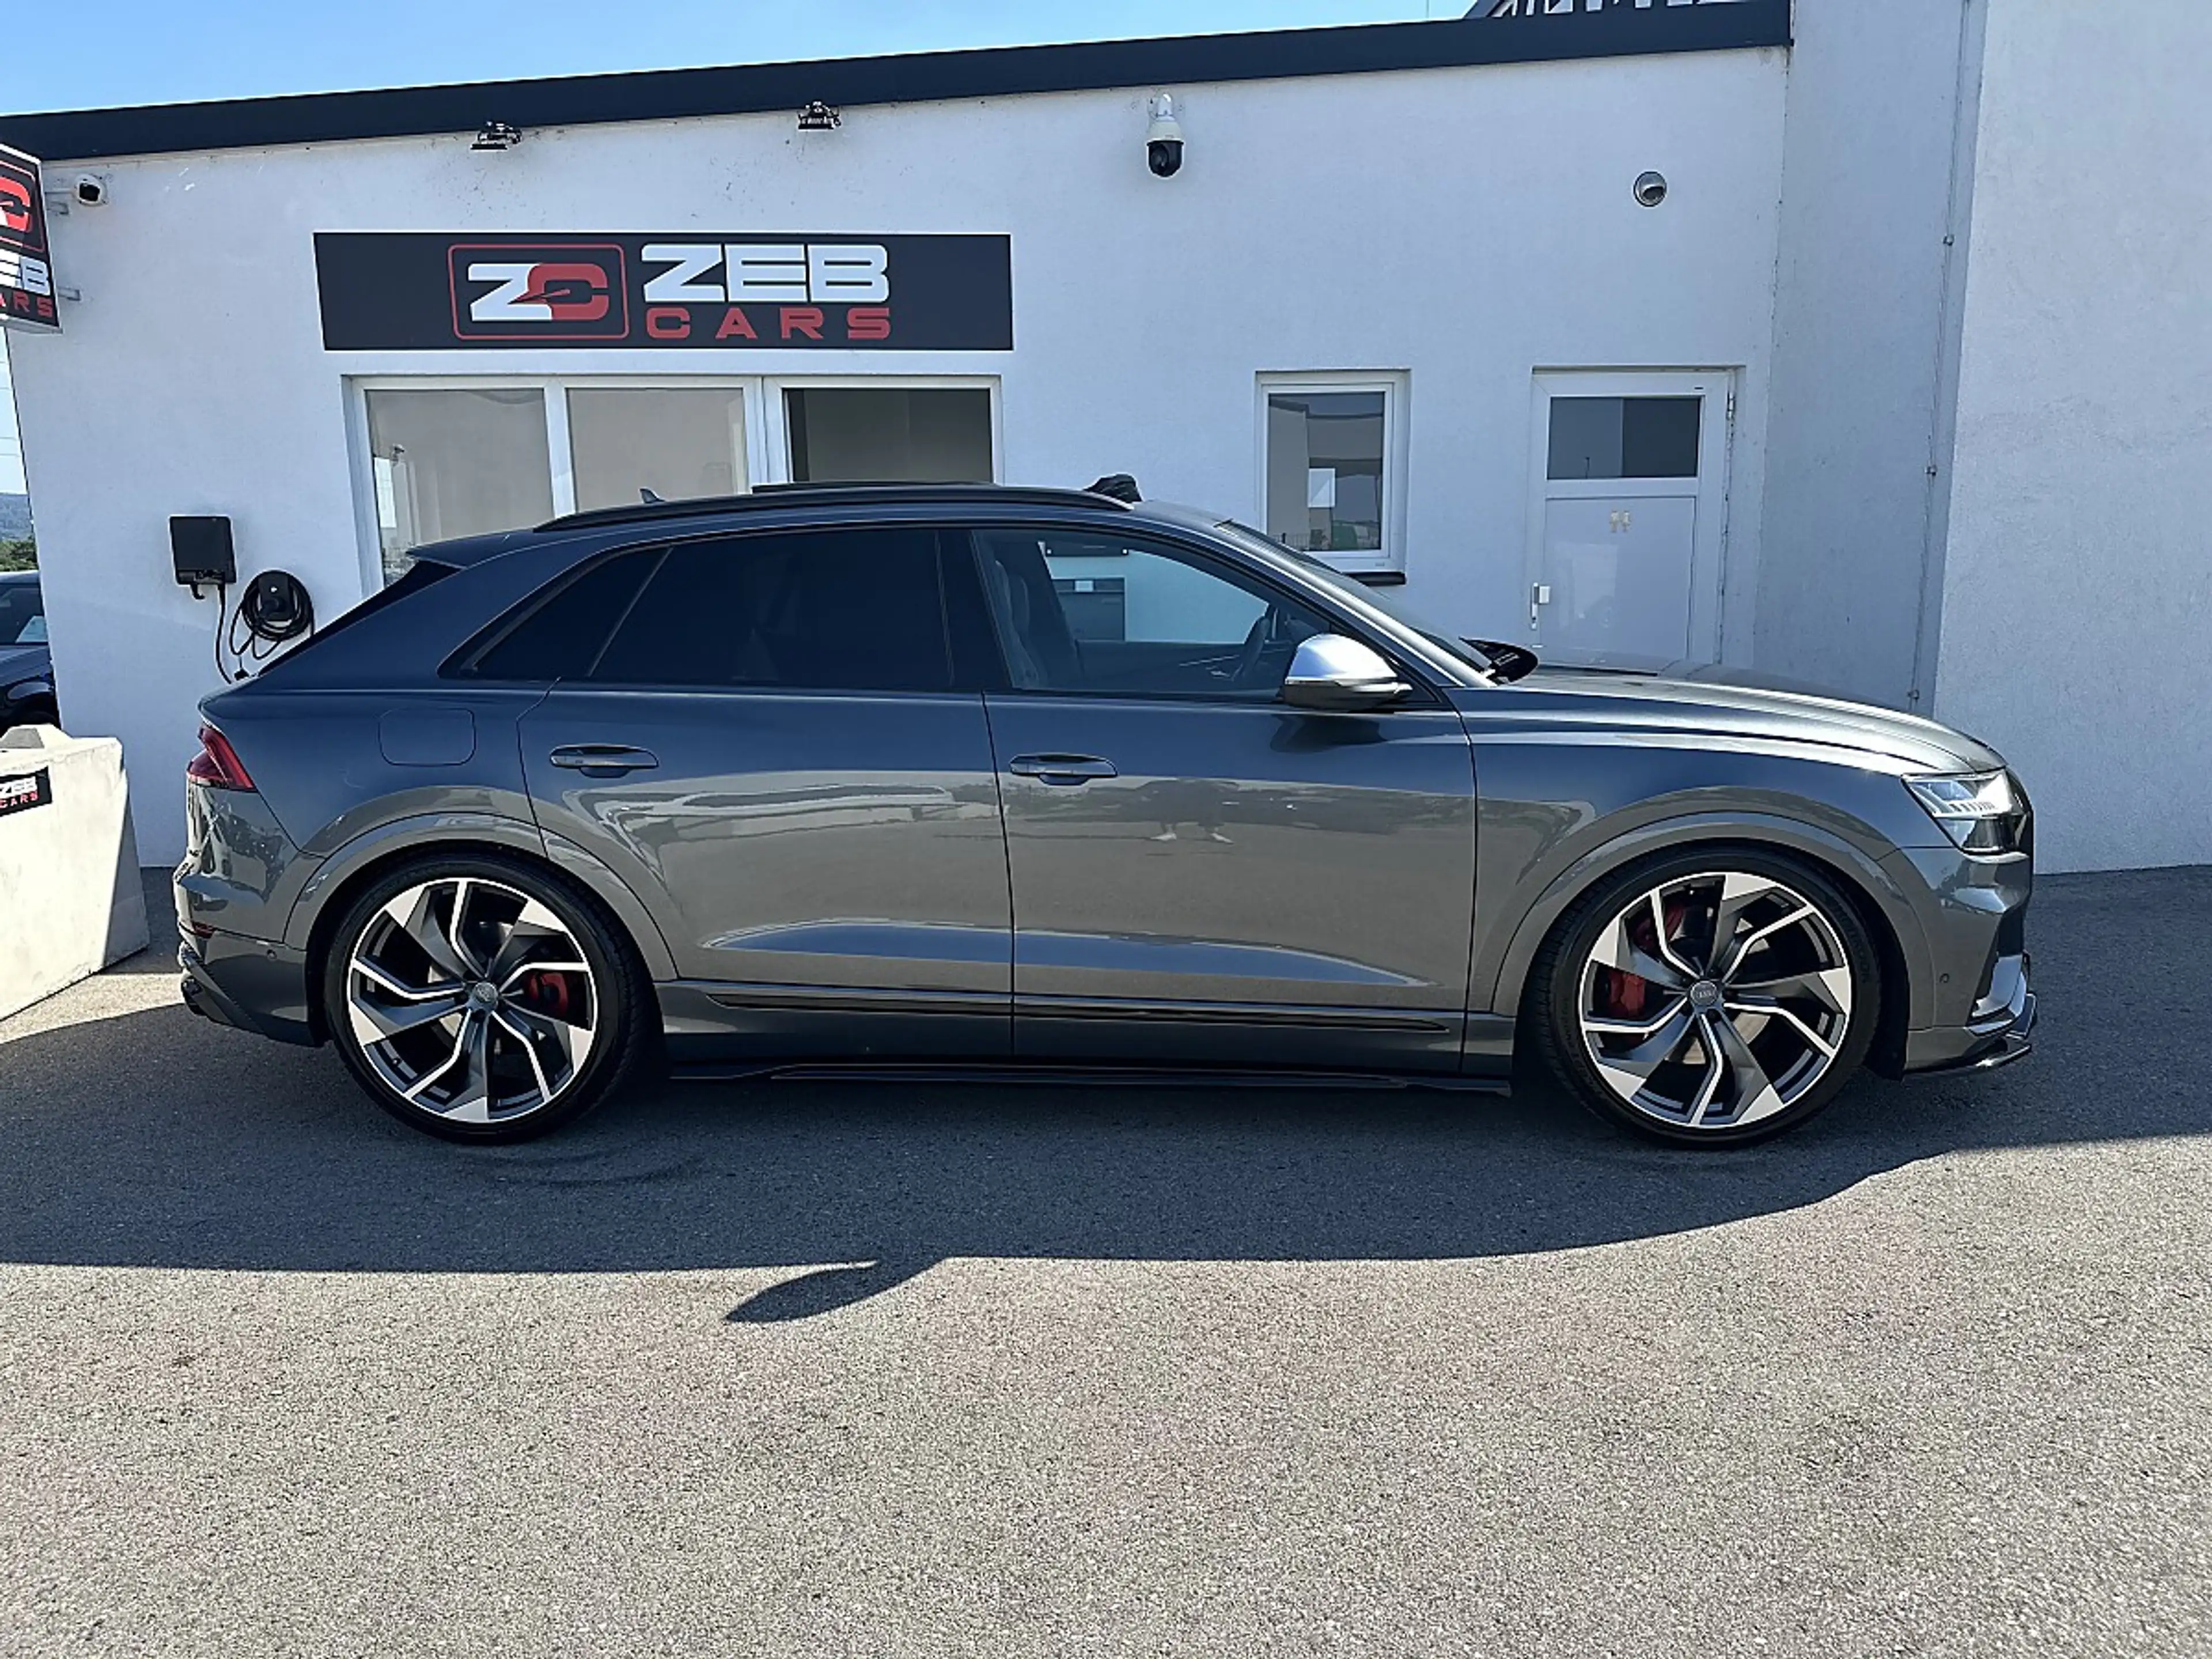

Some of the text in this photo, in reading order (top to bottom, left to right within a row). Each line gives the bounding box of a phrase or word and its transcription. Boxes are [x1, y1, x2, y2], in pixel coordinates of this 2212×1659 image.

[468, 263, 609, 321] ZC
[641, 244, 890, 302] ZEB
[646, 307, 891, 339] CARS
